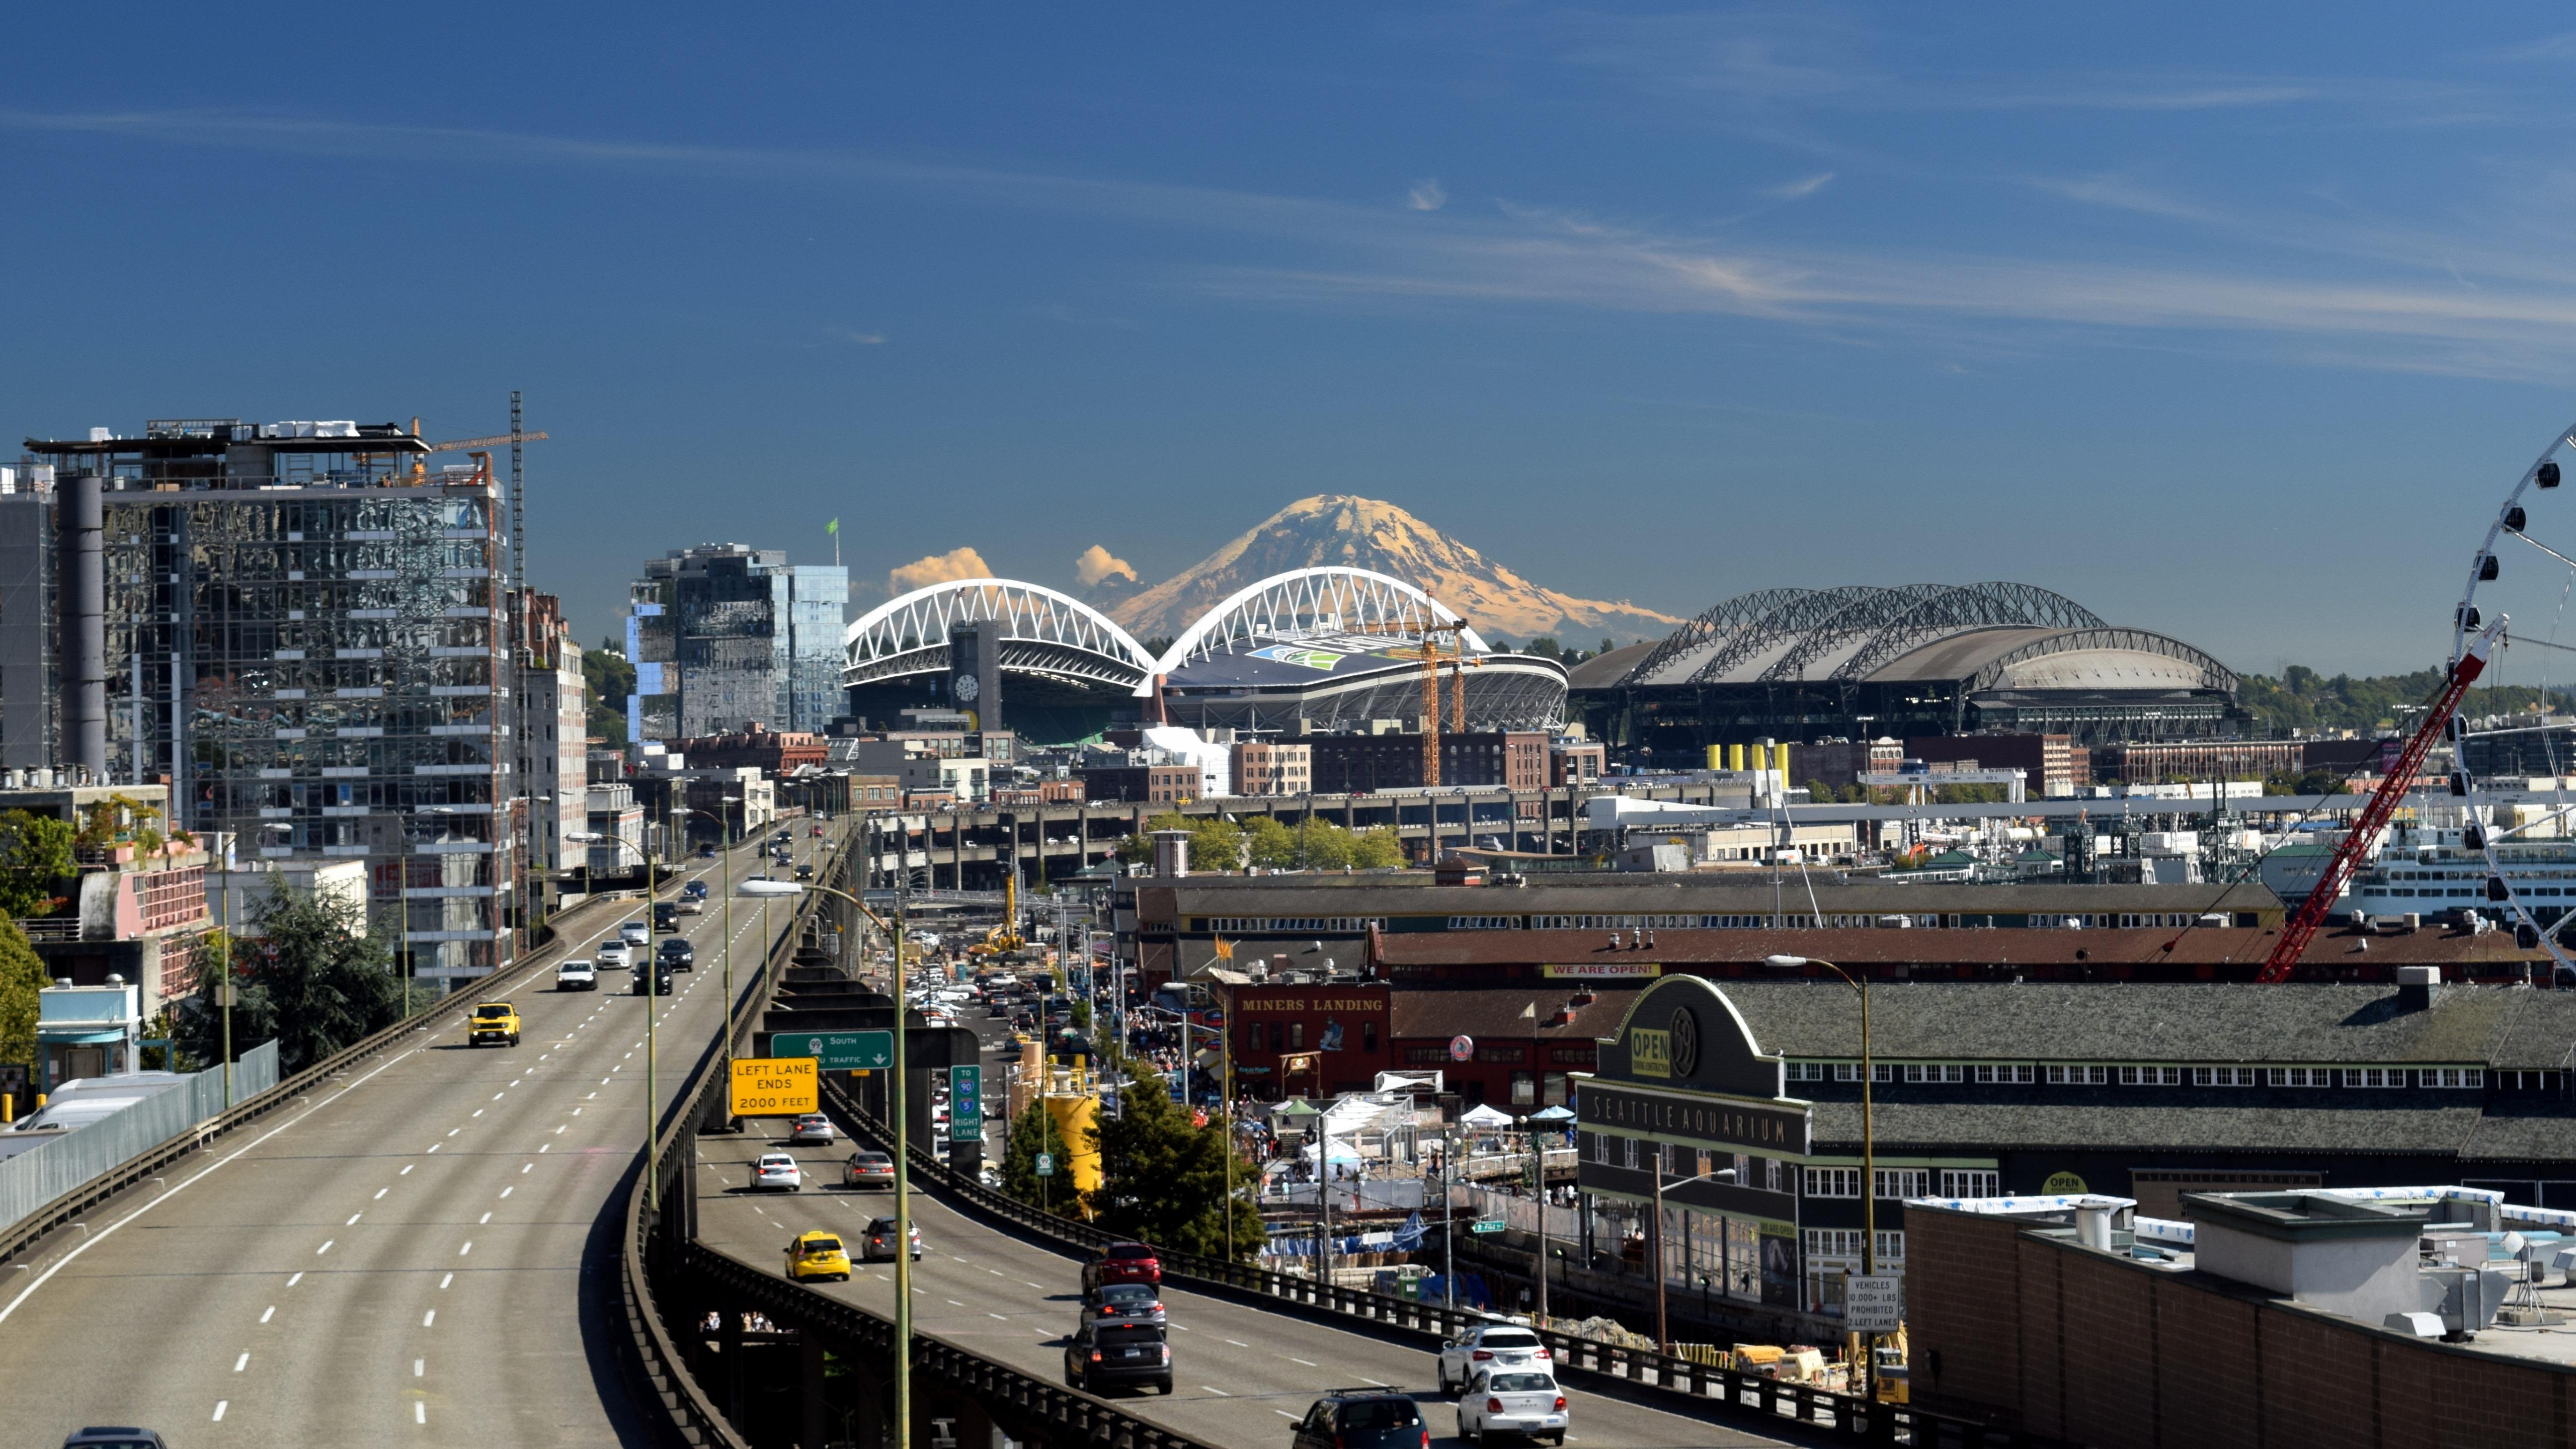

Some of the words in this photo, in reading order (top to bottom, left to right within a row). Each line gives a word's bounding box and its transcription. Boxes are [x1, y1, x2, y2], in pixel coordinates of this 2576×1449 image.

[1609, 965, 1652, 974] OPEN!
[1242, 1000, 1304, 1010] MINERS
[1313, 1000, 1383, 1010] LANDING
[811, 1040, 821, 1049] 99
[1633, 1032, 1669, 1060] OPEN
[1675, 1019, 1691, 1064] 59
[737, 1066, 769, 1075] LEFT
[776, 1065, 812, 1075] LANE
[758, 1079, 792, 1089] ENDS
[740, 1098, 776, 1108] 2000
[783, 1097, 810, 1106] FEET
[954, 1118, 979, 1126] RIGHT
[1594, 1096, 1673, 1128] SEATTLE
[1683, 1108, 1784, 1143] AQUARIUM
[2050, 1178, 2078, 1187] OPEN
[1856, 1281, 1890, 1289] VEHICLES
[1883, 1294, 1896, 1302] LBS
[1852, 1306, 1893, 1314] PROHIBITED
